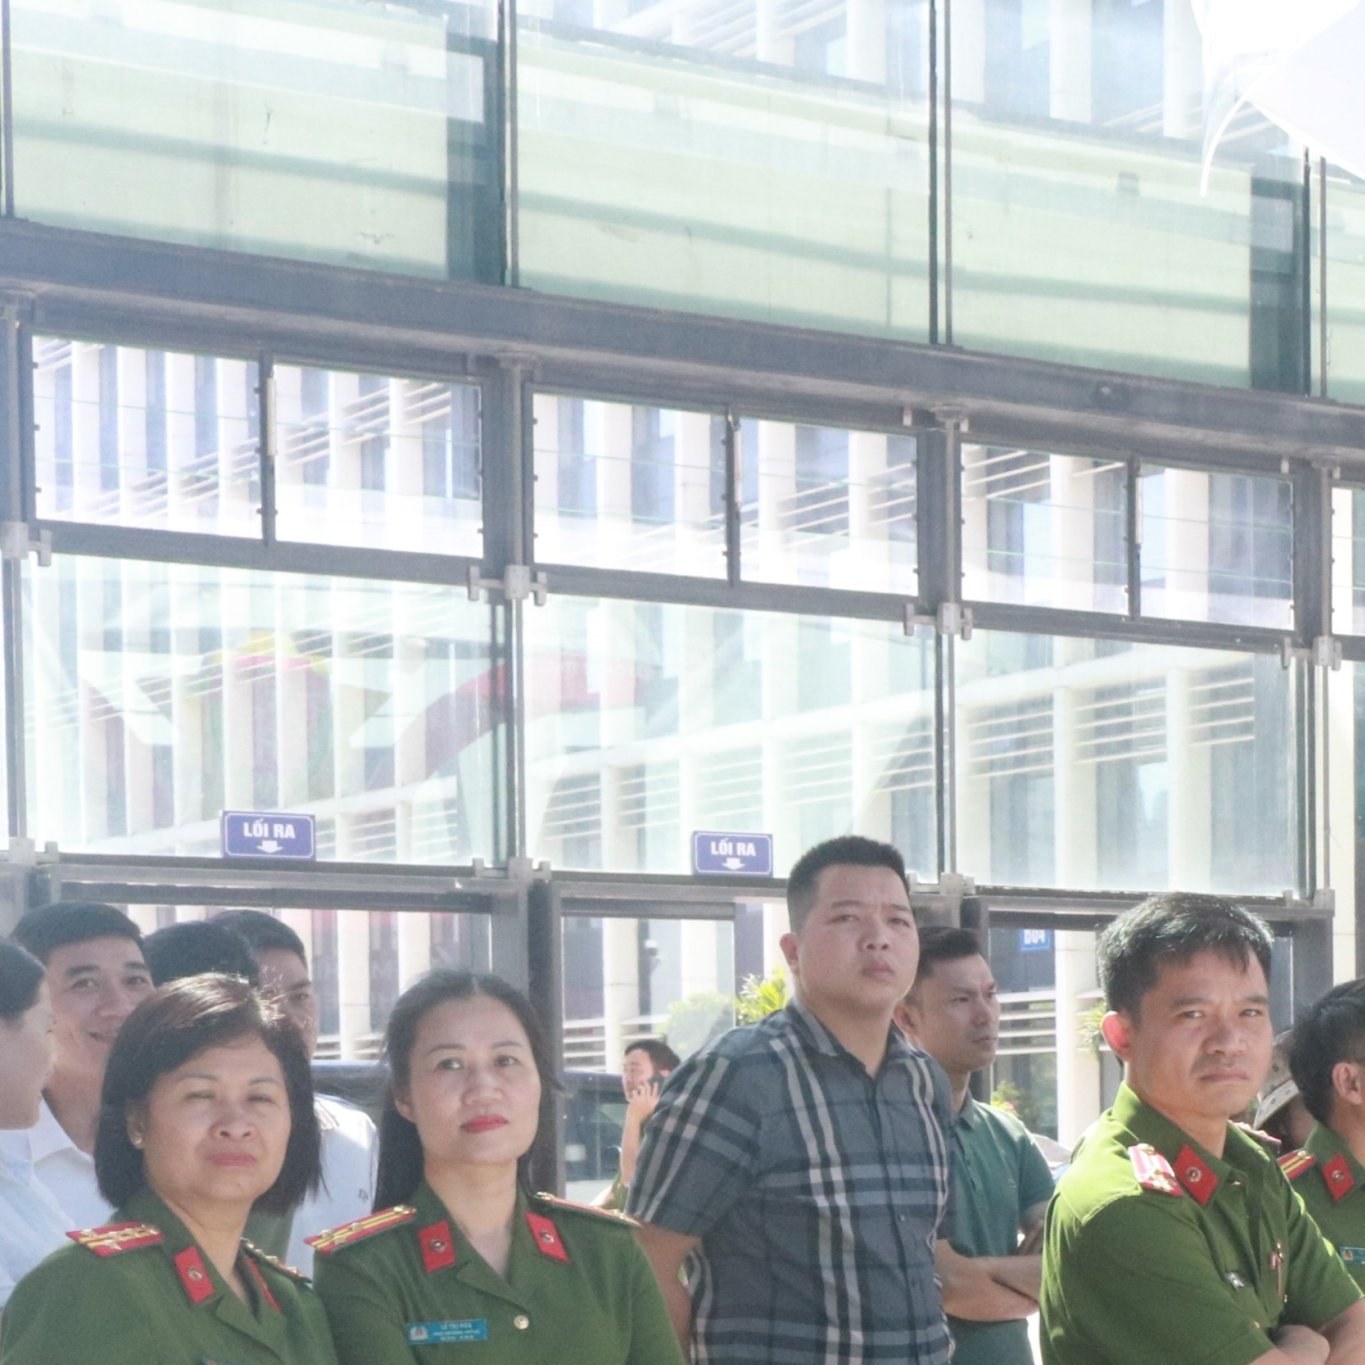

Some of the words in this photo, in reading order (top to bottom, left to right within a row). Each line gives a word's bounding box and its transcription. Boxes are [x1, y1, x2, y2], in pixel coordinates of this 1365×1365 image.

[243, 818, 268, 838] LỐI
[273, 824, 295, 839] RA
[711, 837, 733, 855] LỐI
[737, 842, 756, 856] RA
